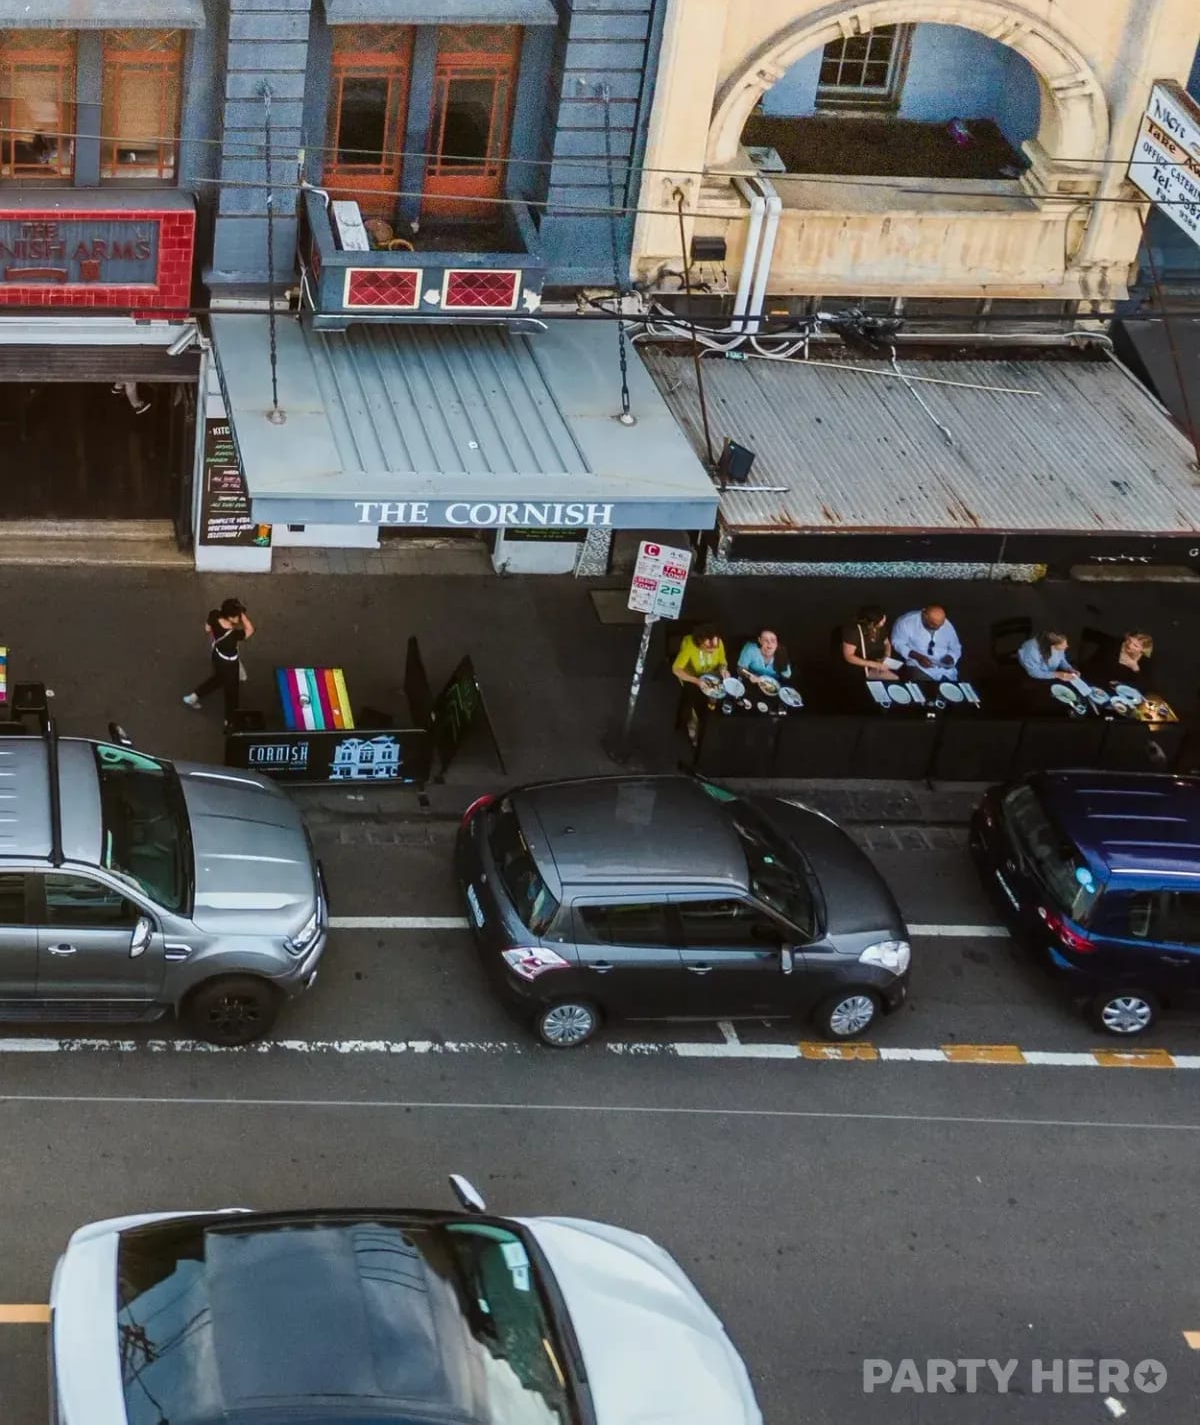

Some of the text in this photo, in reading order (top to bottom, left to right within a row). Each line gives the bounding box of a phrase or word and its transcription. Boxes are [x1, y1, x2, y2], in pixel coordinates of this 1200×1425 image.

[1153, 166, 1173, 193] Tel:
[22, 222, 58, 239] THE
[73, 238, 151, 260] ARMS
[354, 502, 615, 526] THE CORNISH
[660, 584, 681, 595] 2P
[248, 746, 309, 762] CORNISH
